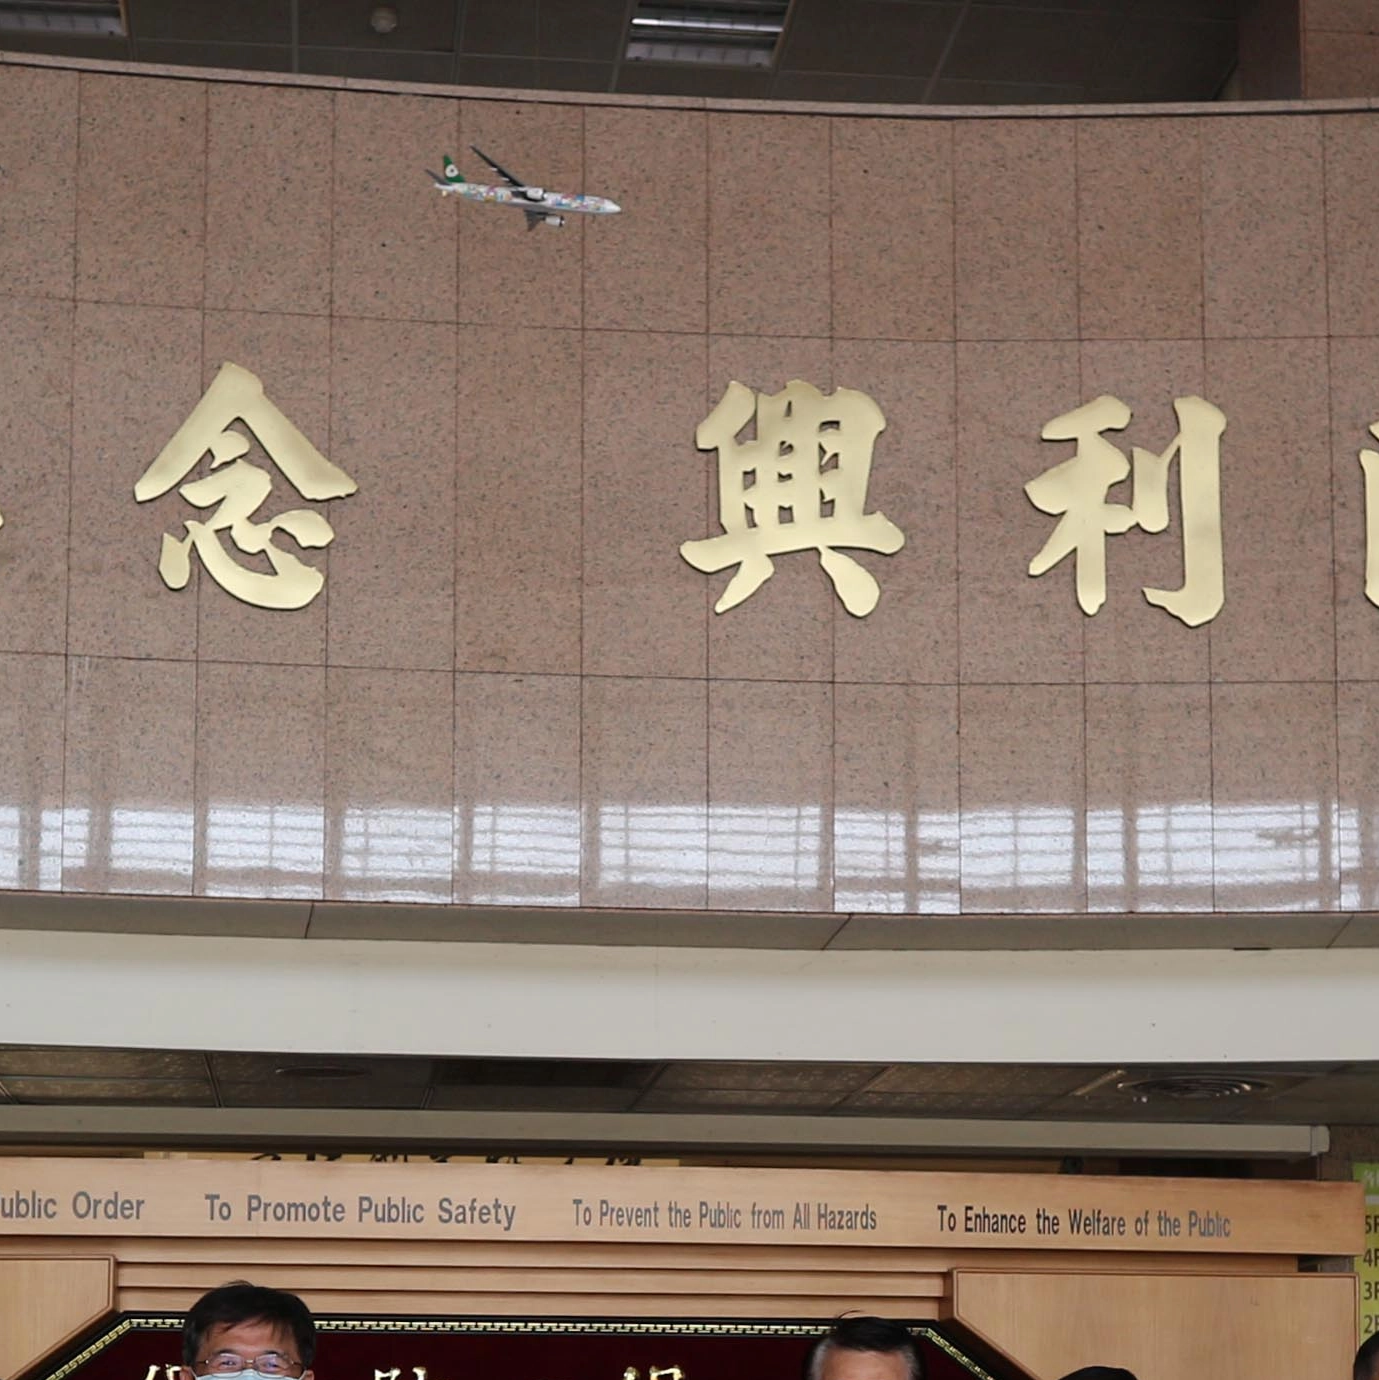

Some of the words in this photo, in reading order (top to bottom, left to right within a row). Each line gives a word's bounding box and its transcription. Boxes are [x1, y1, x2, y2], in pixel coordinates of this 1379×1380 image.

[72, 1191, 145, 1220] Order
[206, 1194, 231, 1222] To
[246, 1195, 344, 1223] Promote
[358, 1195, 424, 1224] Public
[438, 1197, 516, 1231] Safety
[573, 1200, 593, 1227] To
[599, 1202, 660, 1228] Prevent
[668, 1203, 692, 1229] the
[699, 1203, 741, 1229] Public
[751, 1203, 784, 1230] from
[793, 1204, 811, 1230] All
[819, 1204, 877, 1231] Hazards
[938, 1206, 957, 1233] To
[964, 1207, 1025, 1234] Enhance
[1036, 1208, 1059, 1235] the
[1068, 1208, 1127, 1237] Welfare
[1135, 1209, 1151, 1237] of
[1158, 1209, 1181, 1237] the
[1189, 1210, 1231, 1239] Public
